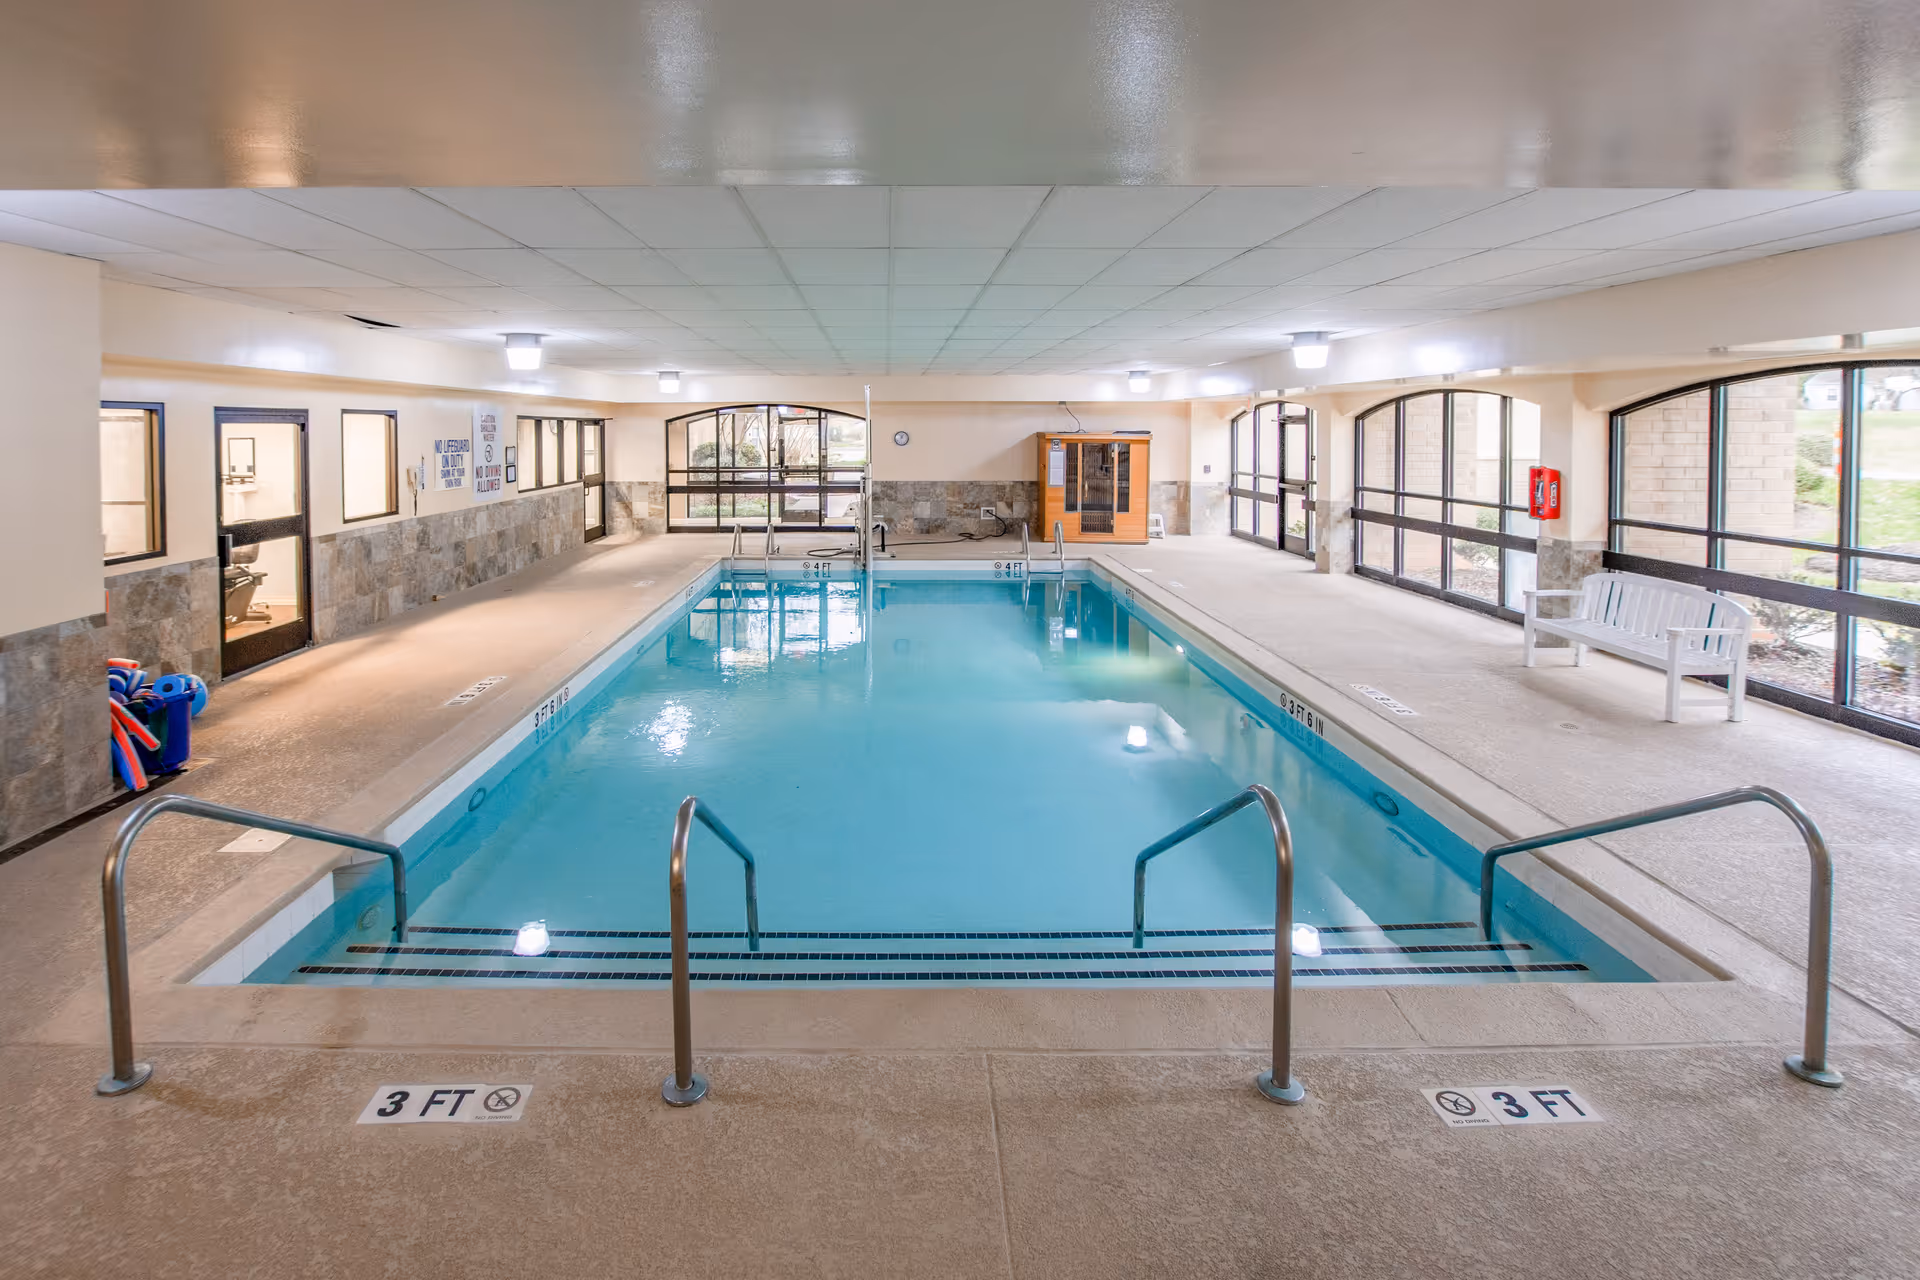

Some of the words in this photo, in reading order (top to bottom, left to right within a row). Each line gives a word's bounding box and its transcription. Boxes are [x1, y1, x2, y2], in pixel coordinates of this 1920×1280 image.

[435, 439, 442, 453] NO
[444, 439, 469, 453] LIFEGUARD
[442, 454, 449, 468] ON
[450, 453, 463, 468] DUTY
[441, 469, 450, 479] SWIM
[456, 467, 465, 476] YOUR
[476, 465, 483, 479] NO
[485, 464, 501, 478] DIVING
[477, 478, 500, 493] ALLOWED
[822, 562, 832, 571] FT
[1013, 562, 1023, 571] FT
[534, 712, 540, 728] 3
[541, 703, 549, 723] FT
[550, 699, 555, 715] 6
[556, 692, 563, 710] IN
[1289, 699, 1295, 715] 3
[1296, 703, 1305, 722] FT
[1307, 711, 1313, 728] 6
[1315, 716, 1324, 737] IN
[377, 1090, 410, 1117] 3
[419, 1089, 476, 1117] FT
[1491, 1091, 1529, 1118] 3
[1528, 1089, 1586, 1118] FT
